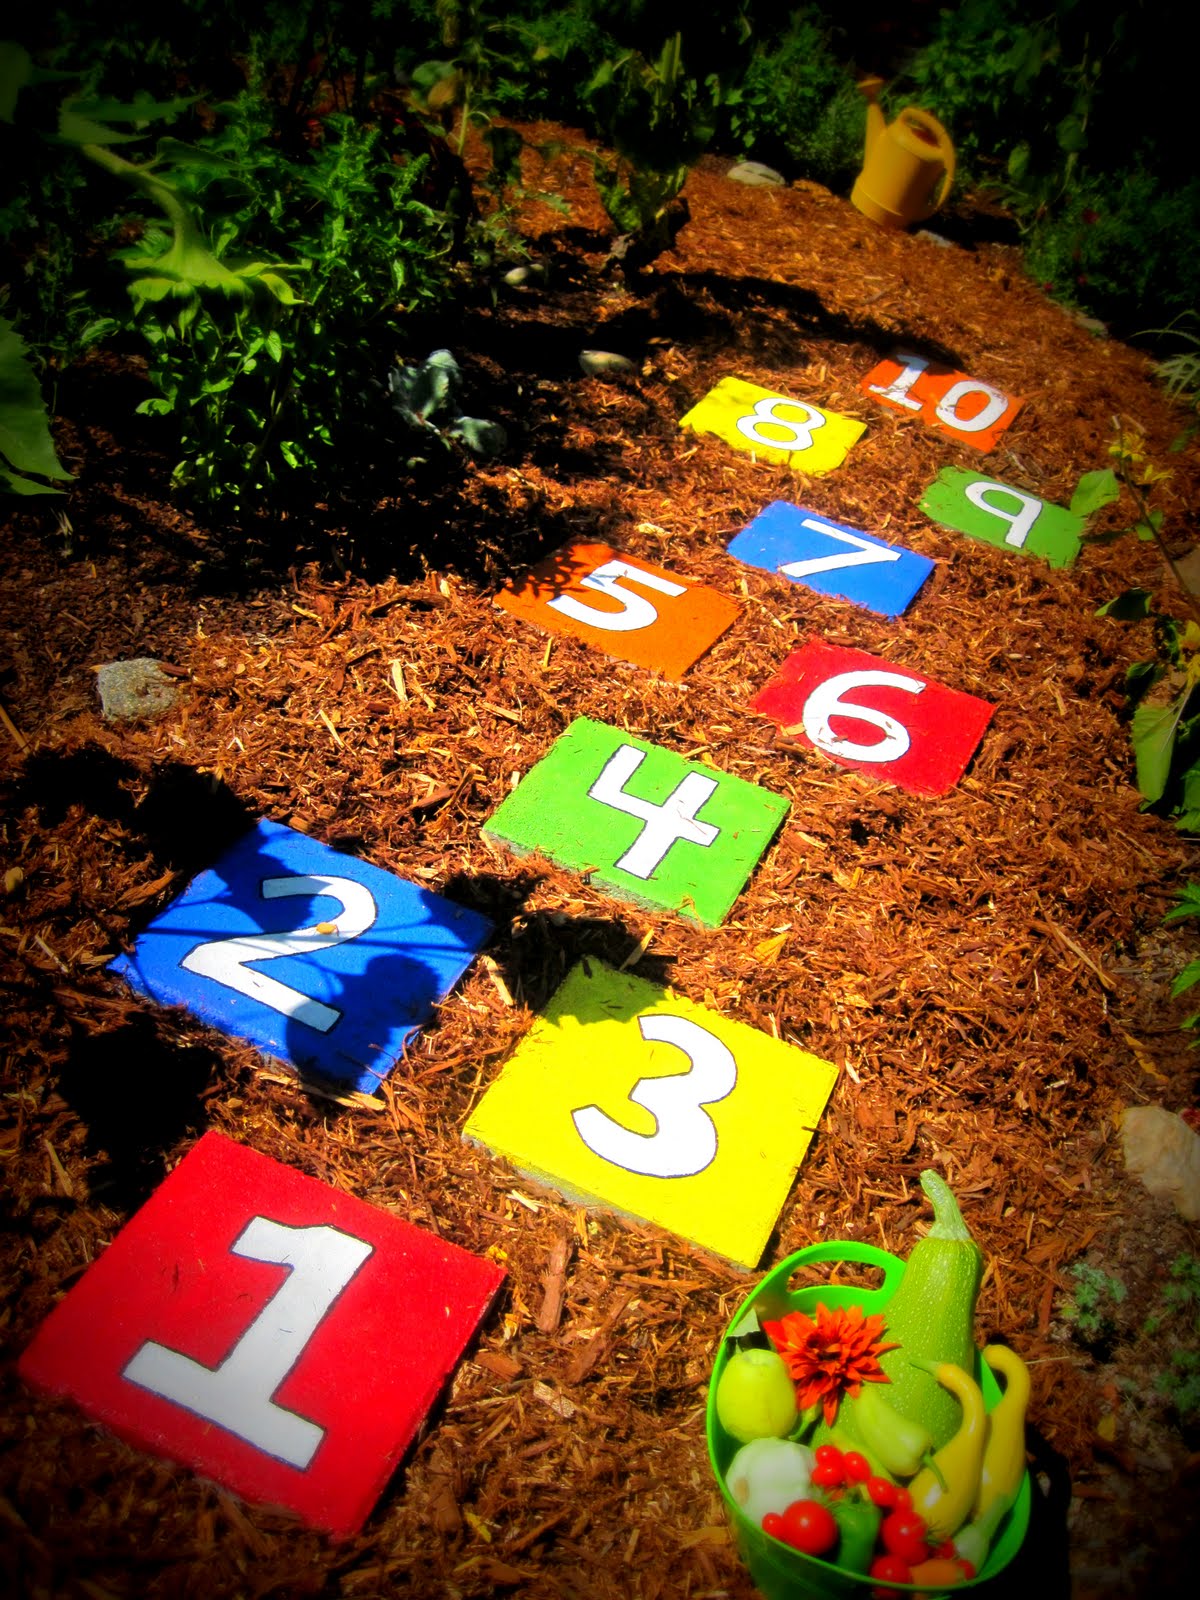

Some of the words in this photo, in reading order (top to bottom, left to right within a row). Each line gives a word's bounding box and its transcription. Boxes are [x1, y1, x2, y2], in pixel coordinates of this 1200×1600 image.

[736, 397, 827, 451] 8
[868, 354, 1009, 432] 10
[777, 518, 902, 578] 7
[964, 480, 1042, 548] 9
[546, 559, 688, 632] 5
[802, 670, 927, 763] 6
[587, 744, 721, 880] 4
[179, 875, 378, 1035] 2
[571, 1014, 738, 1179] 3
[121, 1215, 374, 1471] 1
